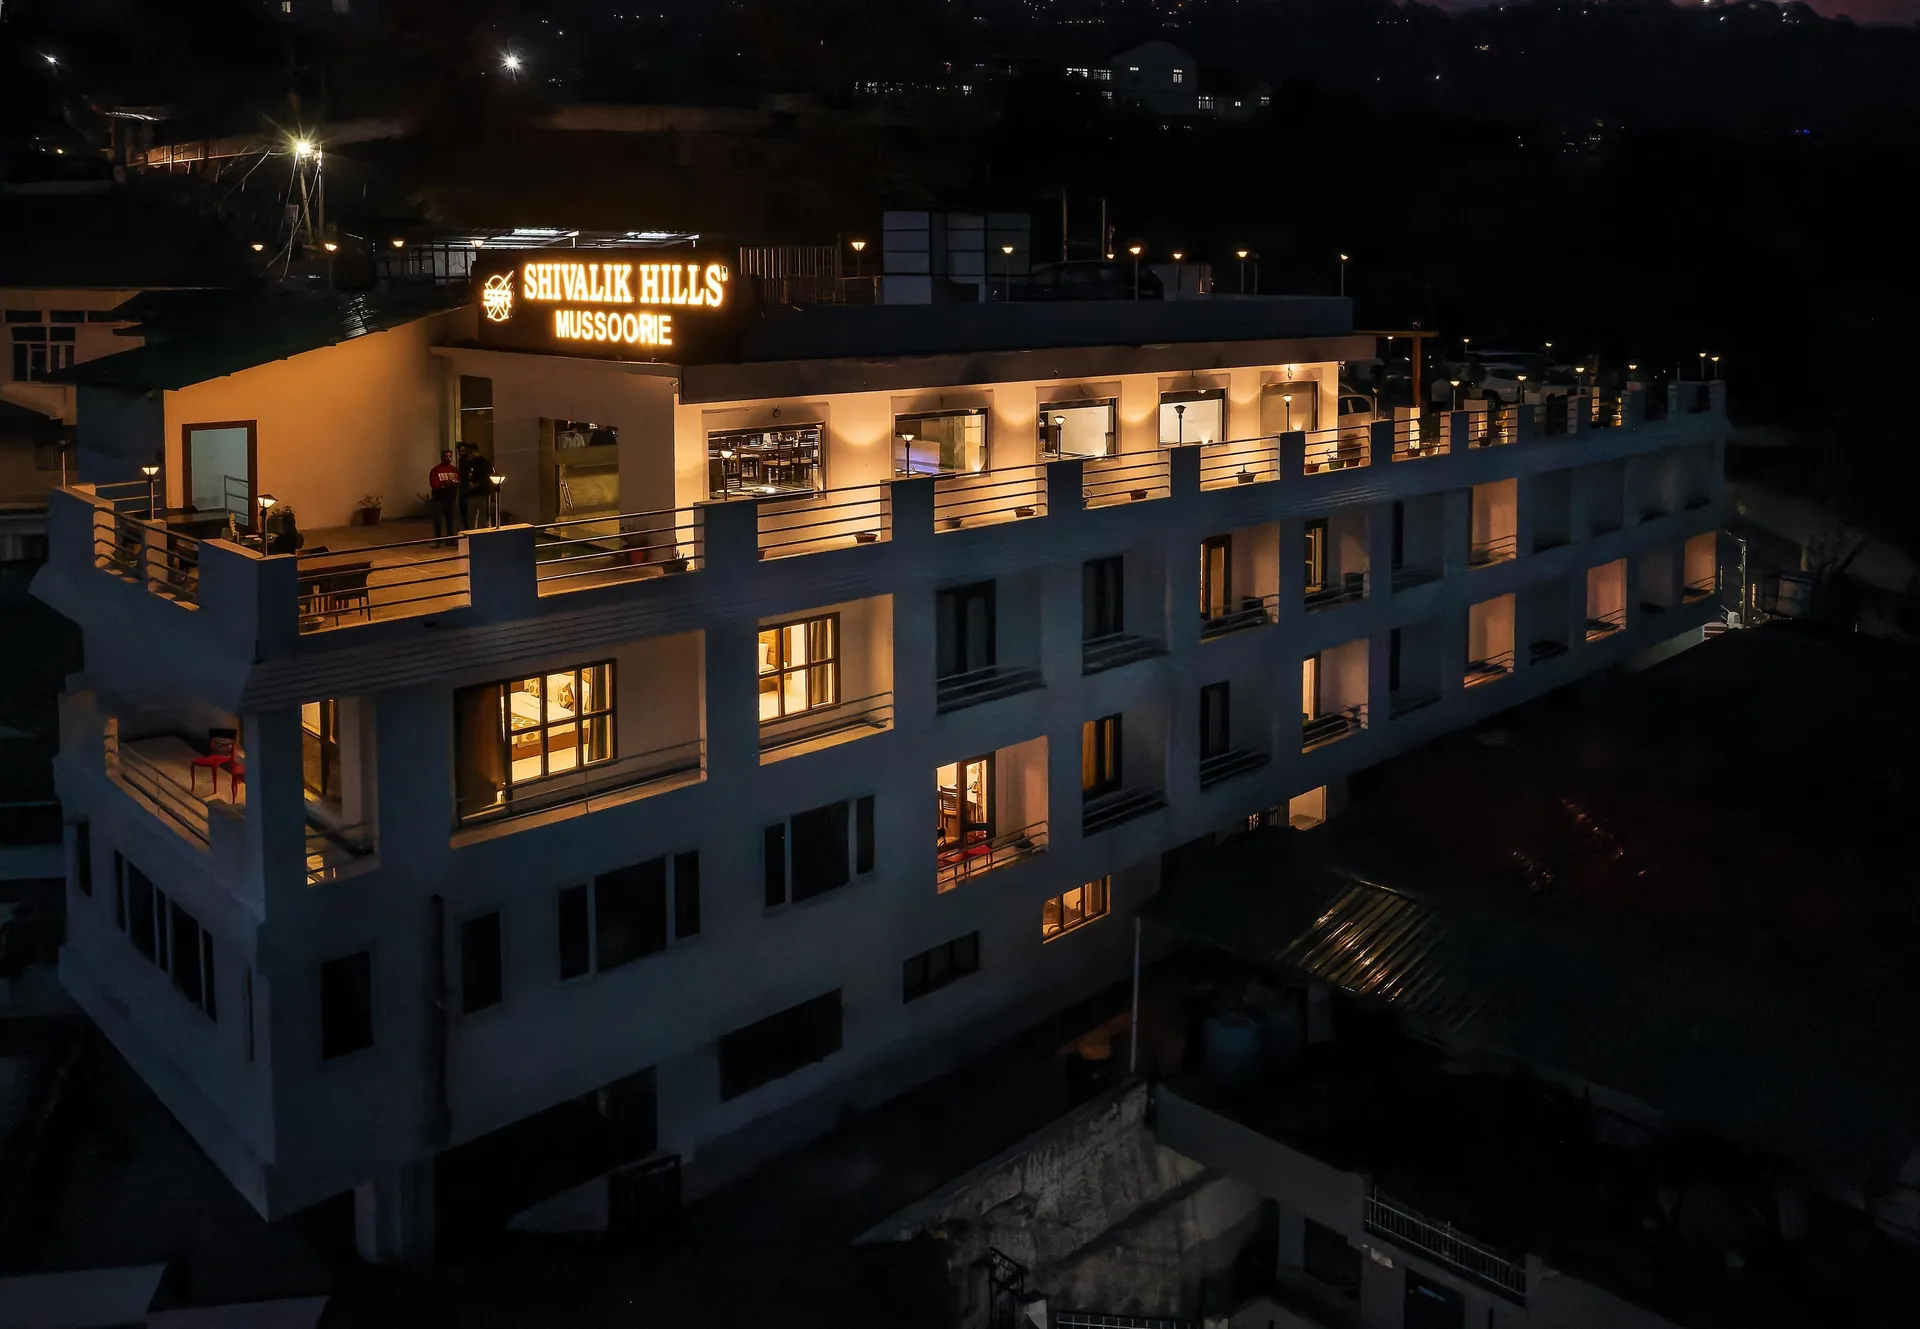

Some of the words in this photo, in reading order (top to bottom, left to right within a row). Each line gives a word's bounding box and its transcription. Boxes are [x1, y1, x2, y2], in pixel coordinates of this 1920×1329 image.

[524, 263, 634, 303] SHIVALIK
[640, 263, 723, 307] HILLS
[555, 310, 672, 345] MUSSOORIE
